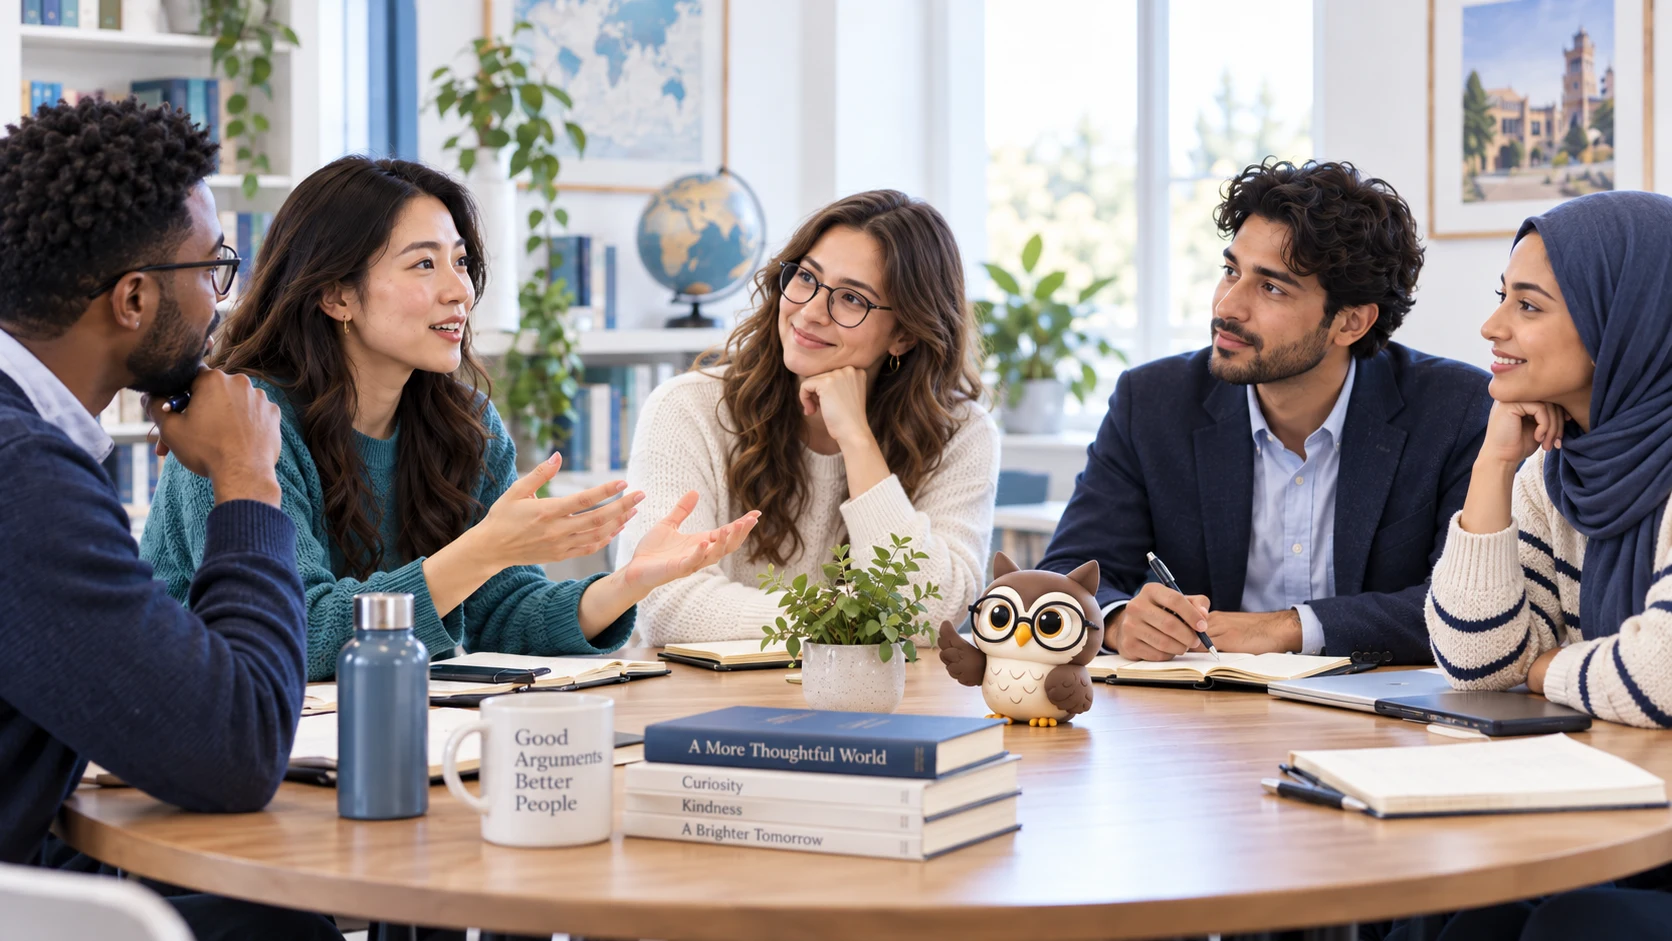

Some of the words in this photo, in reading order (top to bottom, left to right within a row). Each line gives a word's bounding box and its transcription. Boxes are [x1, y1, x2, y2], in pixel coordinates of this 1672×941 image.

[515, 728, 568, 746] Good
[514, 750, 603, 771] Arguments
[688, 739, 701, 755] A
[705, 741, 746, 758] More
[749, 743, 836, 763] Thoughtful
[839, 747, 887, 766] World
[515, 773, 573, 789] Better
[681, 775, 744, 796] Curiosity
[515, 794, 577, 816] People
[681, 799, 743, 816] Kindness
[681, 822, 692, 836] A
[695, 824, 751, 842] Brighter
[754, 828, 824, 846] Tomorrow
